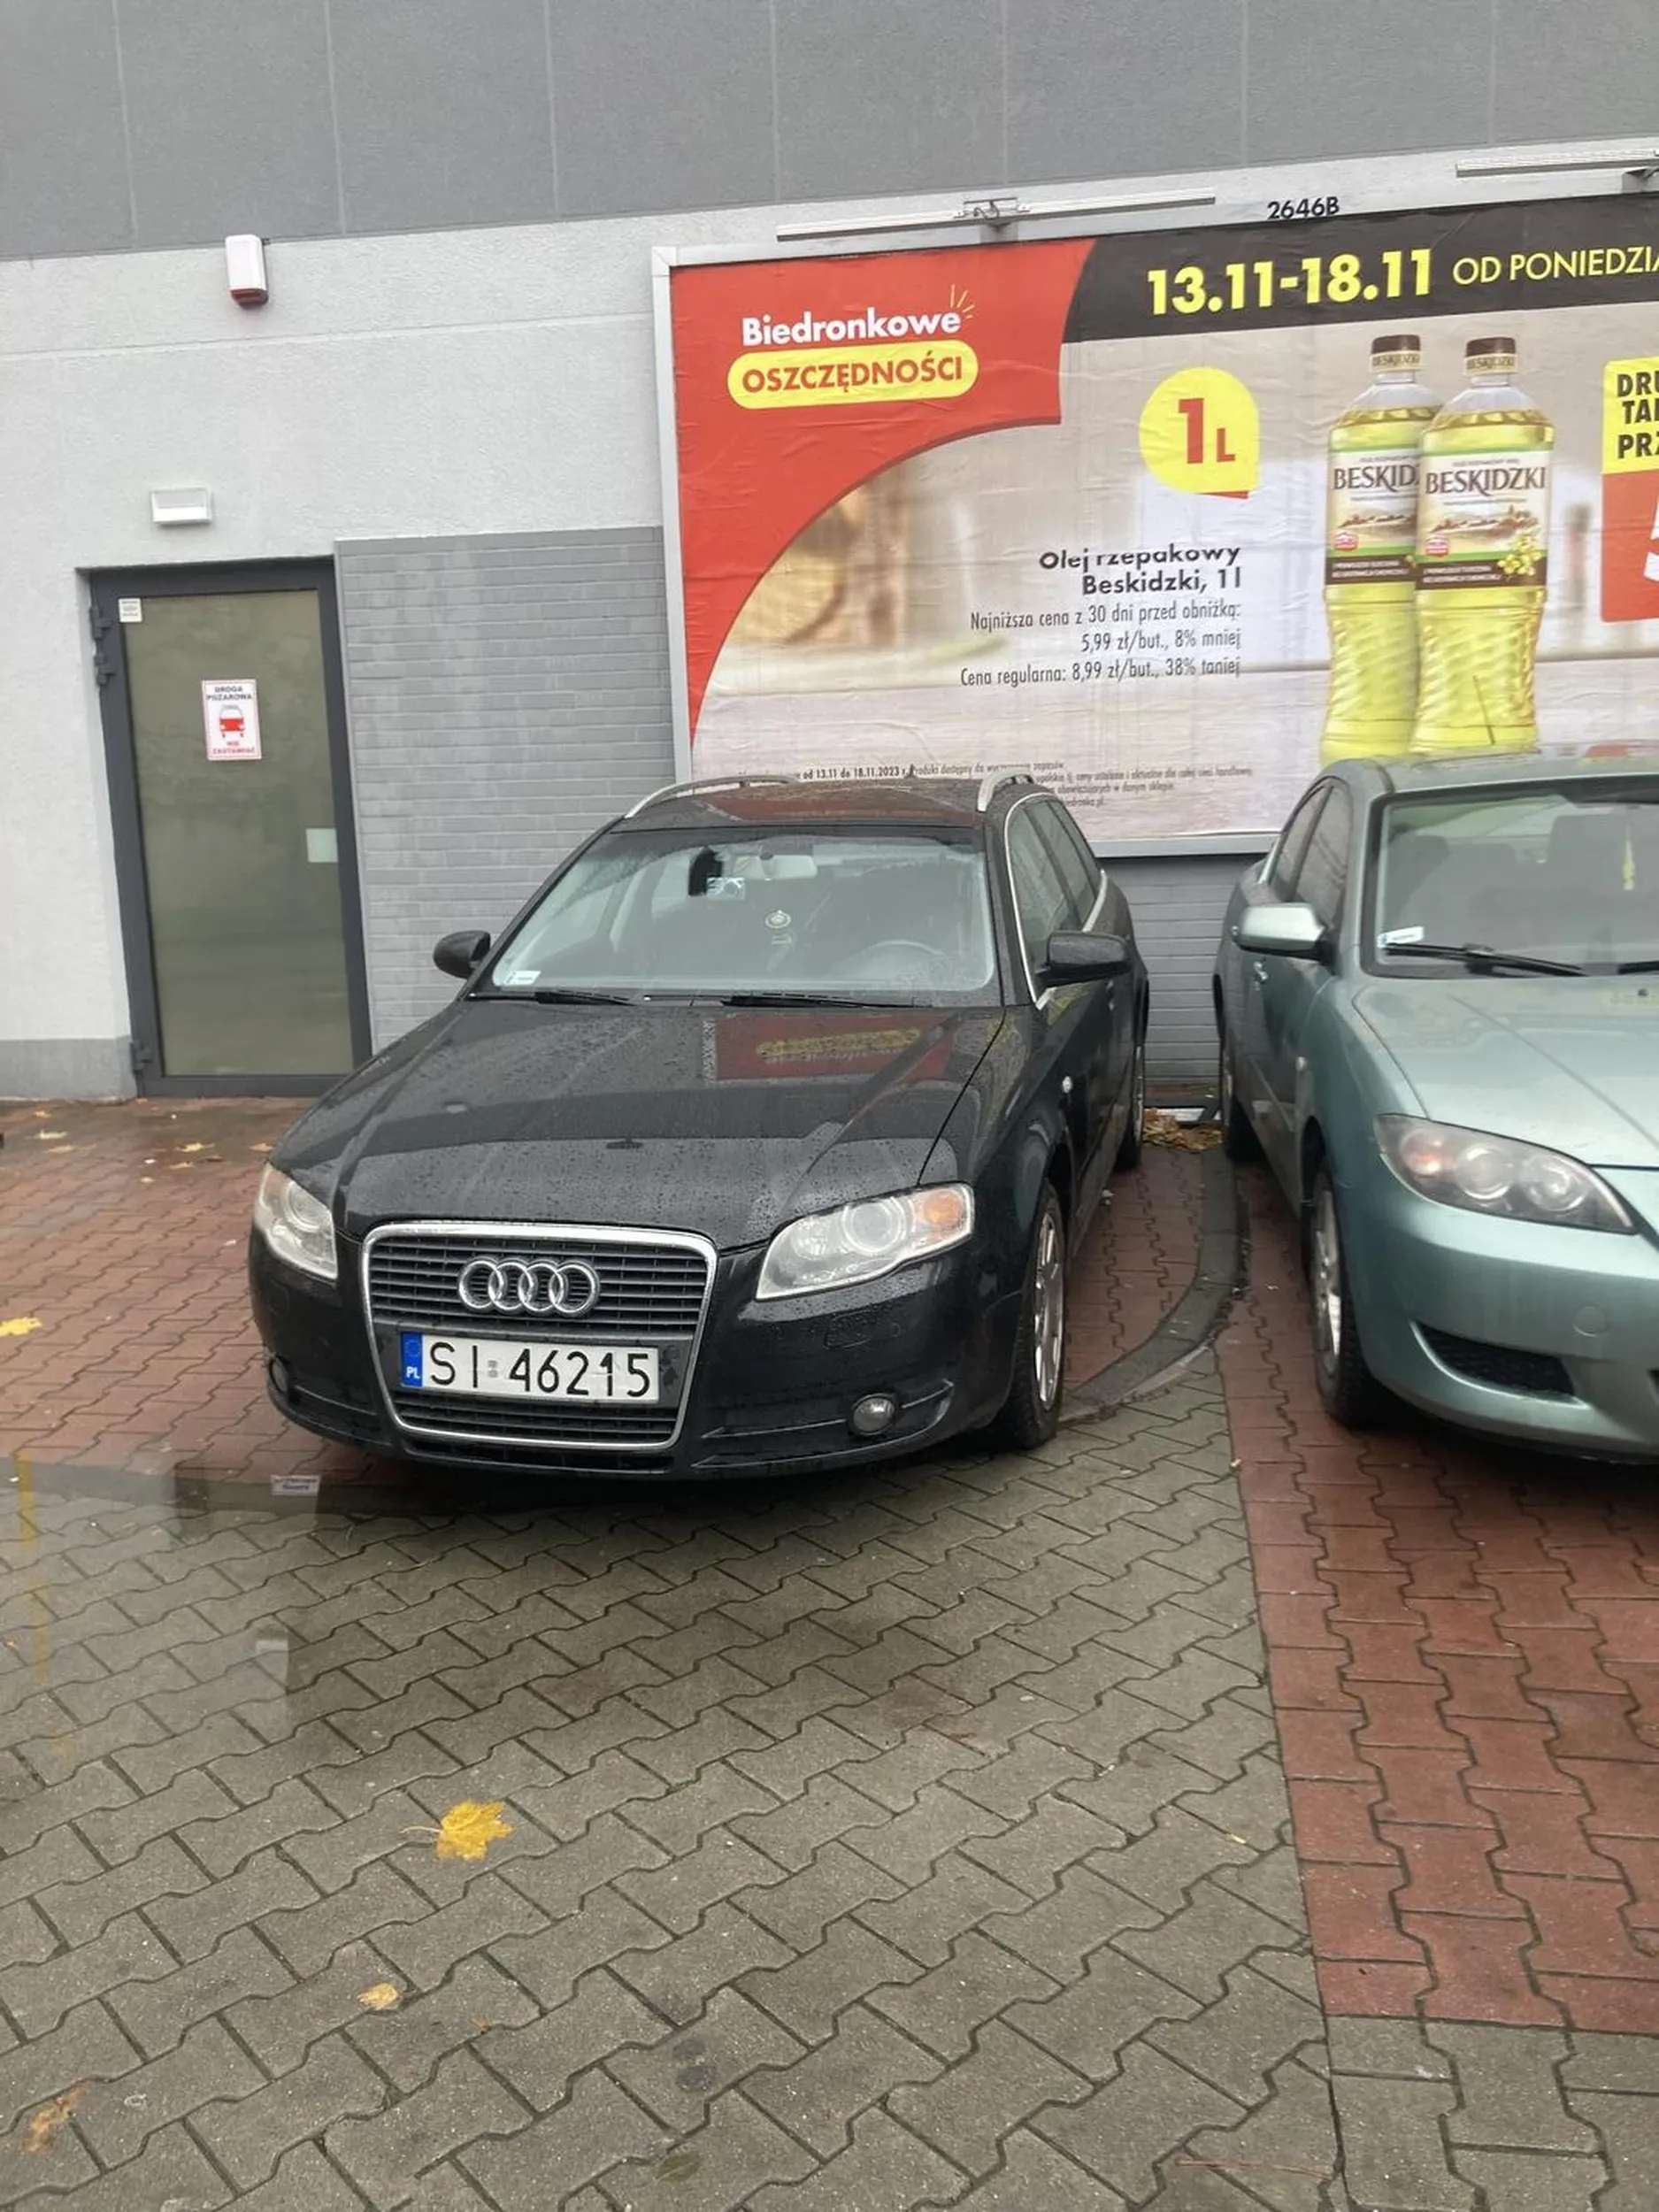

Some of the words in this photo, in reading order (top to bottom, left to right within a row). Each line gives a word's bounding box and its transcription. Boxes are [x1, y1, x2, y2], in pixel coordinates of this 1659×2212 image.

[1267, 196, 1339, 219] 2646B
[1148, 249, 1432, 315] 13.11-18.11
[1453, 256, 1502, 285] OD
[1509, 246, 1659, 280] PONIEDZI
[742, 307, 961, 346] Biedronkowe
[741, 350, 963, 394] OSZCZĘDNOŚCI
[1425, 467, 1546, 496] BESKIDZKI
[1040, 548, 1089, 572] Olej
[1096, 543, 1240, 570] rzepakowy
[1082, 568, 1208, 595] Beskidzki,
[971, 611, 1033, 633] Najniższa
[1040, 615, 1069, 626] cena
[1075, 614, 1083, 625] z
[1088, 605, 1106, 623] 30
[1112, 603, 1133, 622] dni
[1139, 602, 1177, 625] przed
[1182, 598, 1241, 620] obniżką:
[1081, 634, 1111, 653] 5,99
[1118, 630, 1169, 654] zł/but.,
[1175, 629, 1196, 648] 8%
[1202, 629, 1241, 651] mniej
[960, 668, 992, 686] Cena
[997, 664, 1066, 687] regularna:
[1072, 663, 1102, 683] 8,99
[1108, 659, 1159, 682] zł/but.,
[1164, 657, 1195, 676] 38%
[1202, 657, 1241, 678] taniej
[803, 769, 814, 780] od
[816, 769, 837, 780] 13.11
[841, 768, 850, 779] do
[853, 765, 900, 778] 18.11.2023
[406, 1366, 420, 1379] PL
[430, 1341, 479, 1388] SI
[509, 1348, 650, 1398] 46215
